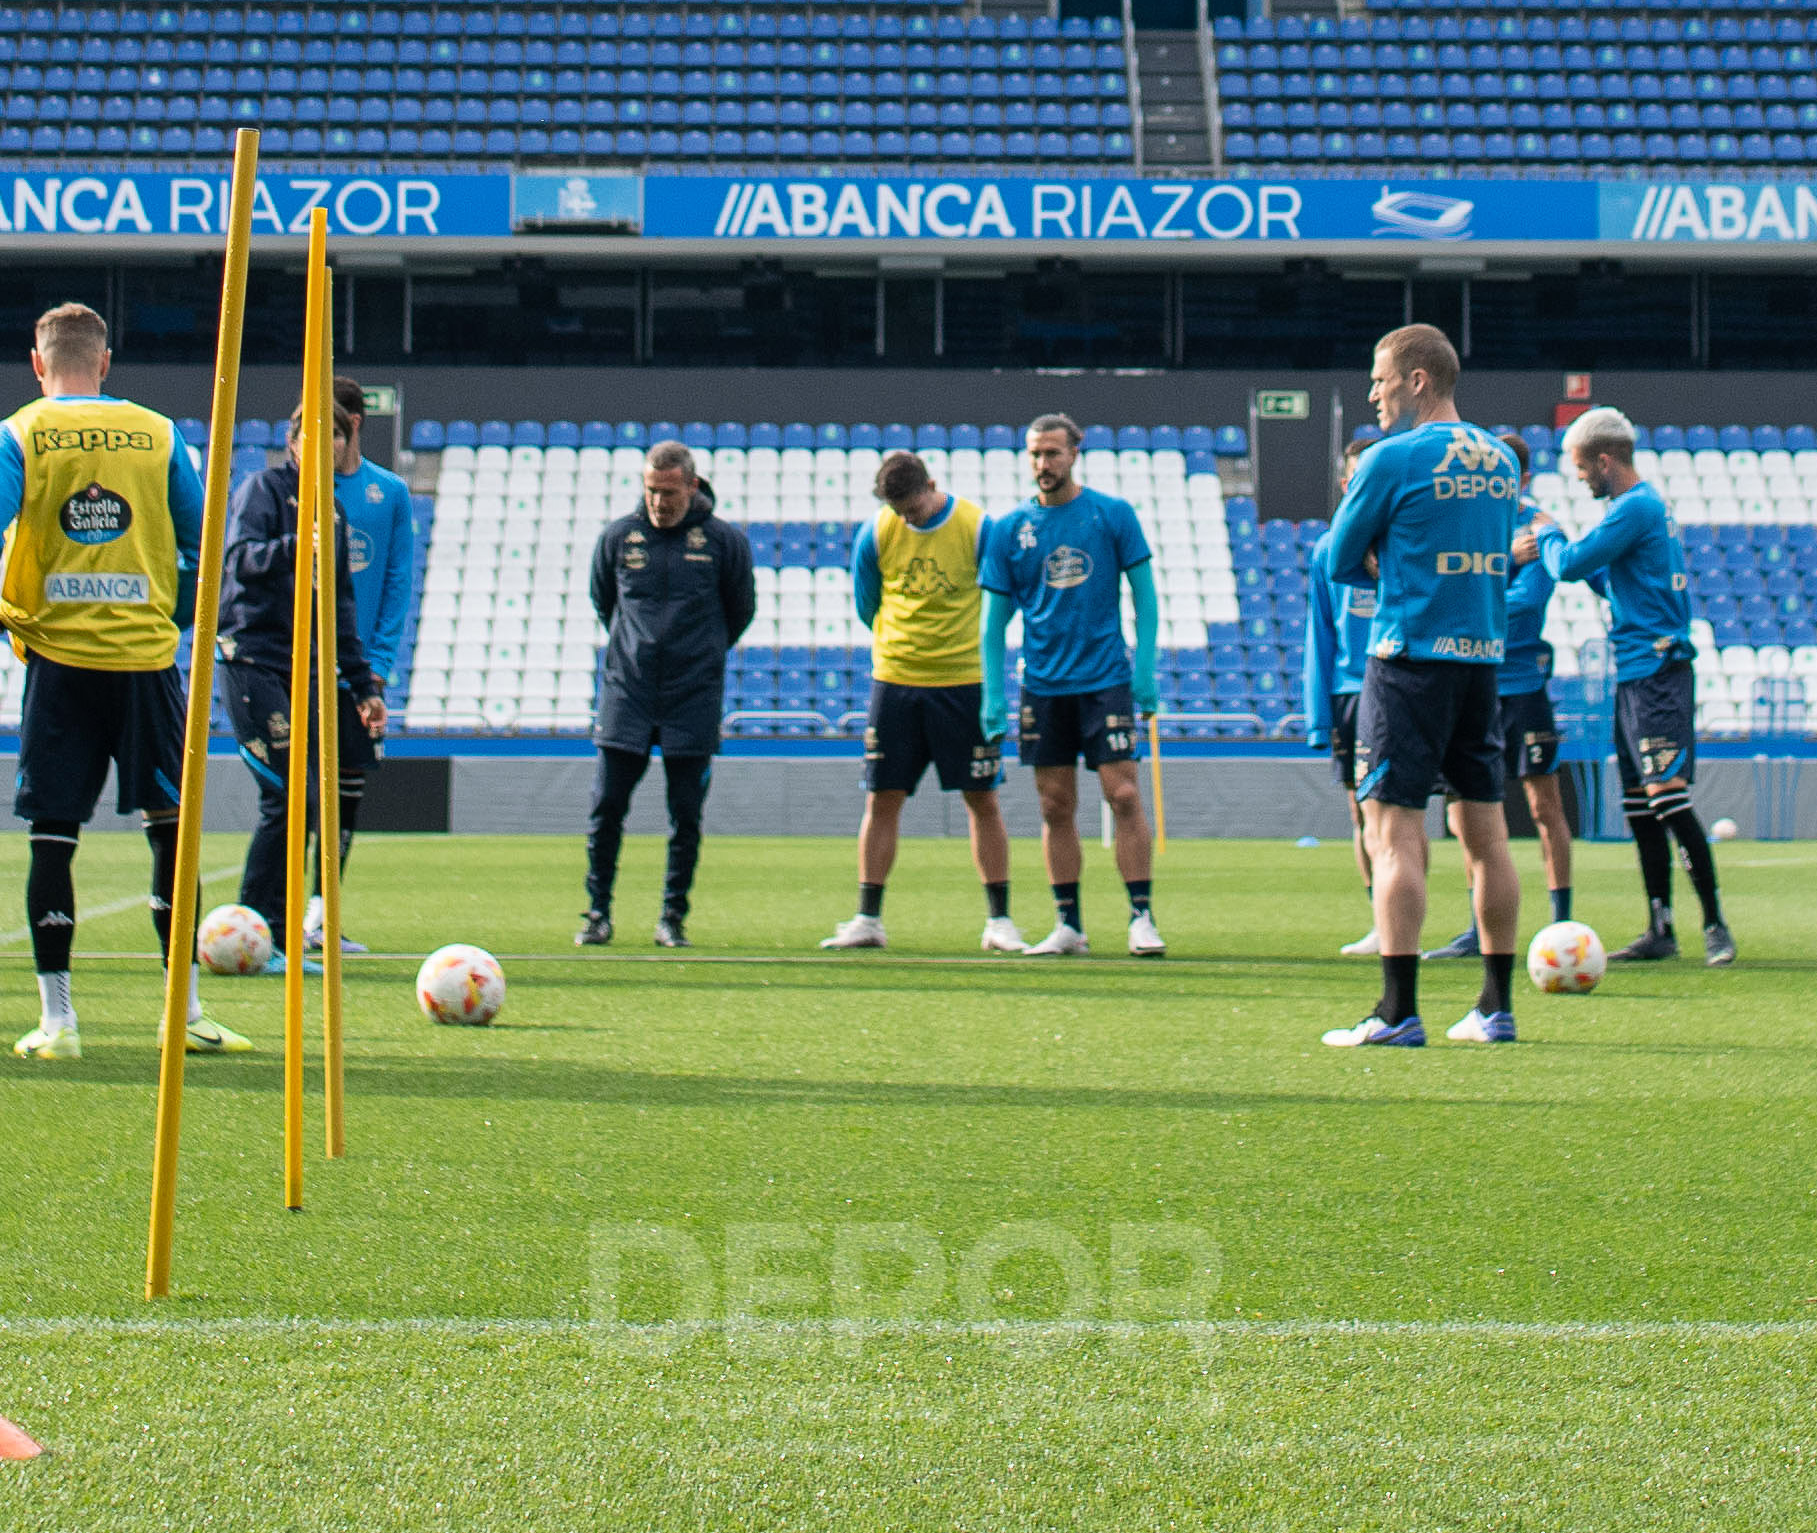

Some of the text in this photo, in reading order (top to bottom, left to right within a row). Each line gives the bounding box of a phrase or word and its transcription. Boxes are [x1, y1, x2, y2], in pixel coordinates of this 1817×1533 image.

[170, 179, 439, 233] RIAZOR
[1034, 185, 1302, 239] RIAZOR
[33, 428, 153, 456] Kappa
[69, 498, 121, 518] Estrella
[70, 515, 119, 532] Galicia
